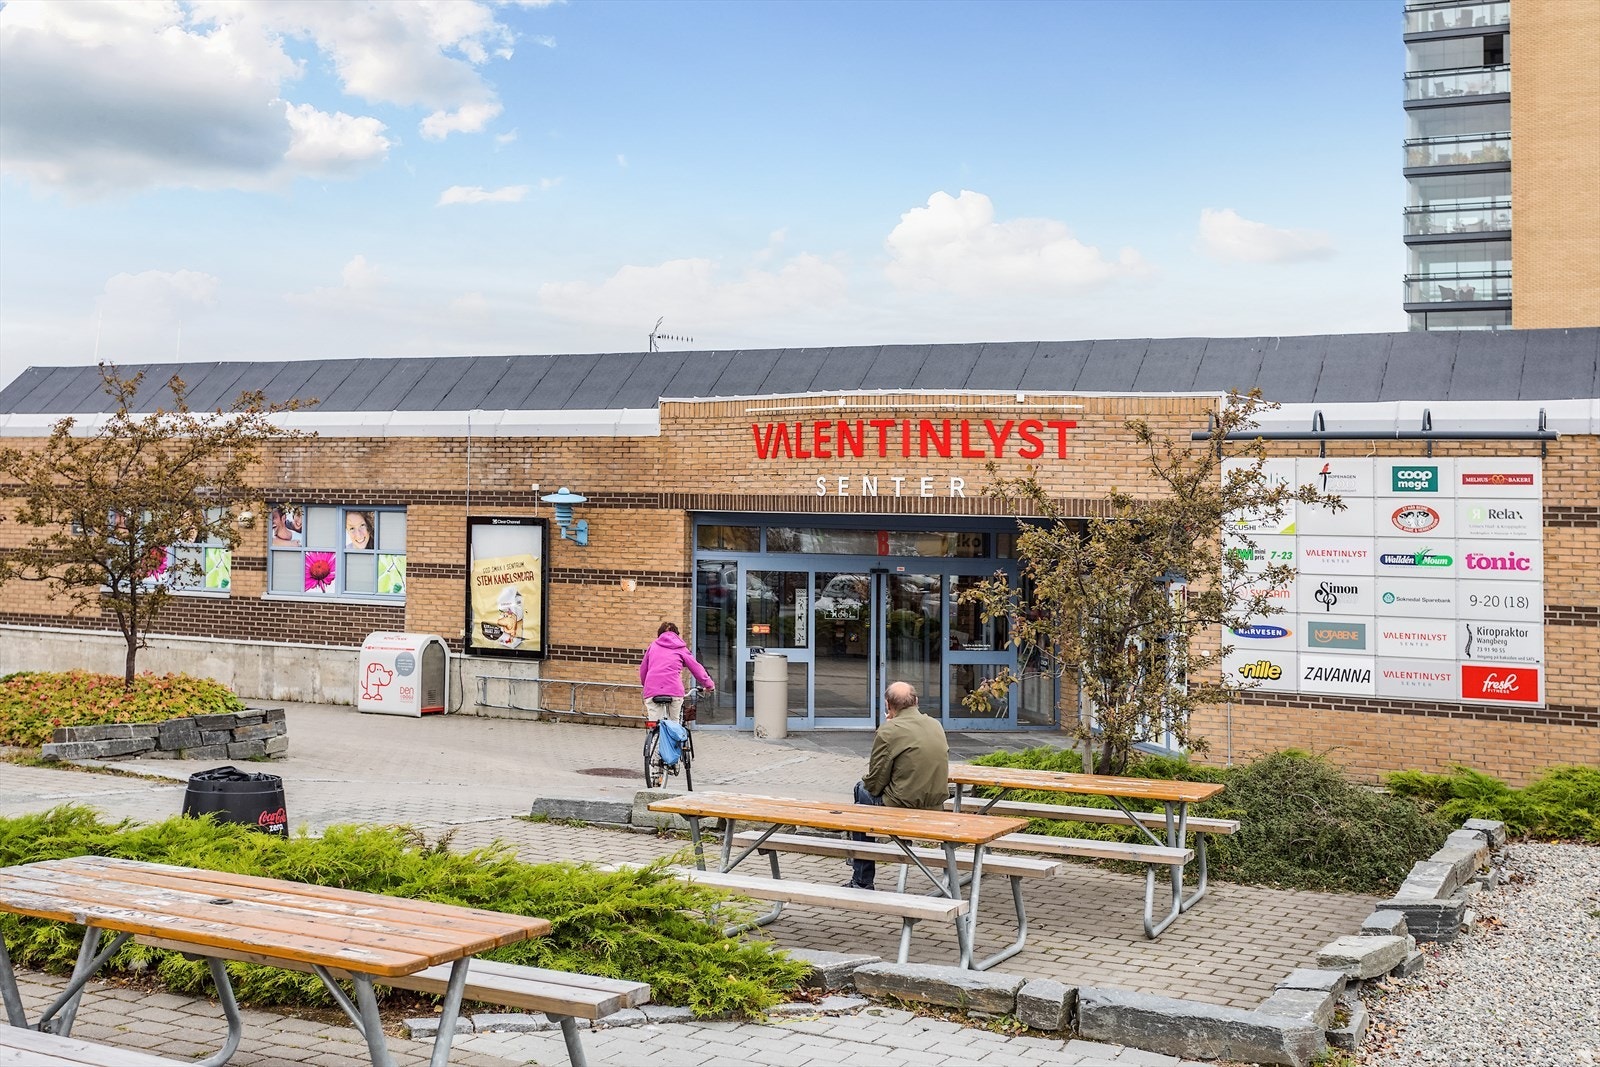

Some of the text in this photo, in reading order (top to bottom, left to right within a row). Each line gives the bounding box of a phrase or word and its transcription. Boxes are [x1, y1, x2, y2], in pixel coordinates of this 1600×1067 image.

[752, 419, 1077, 459] VALENTINLYST
[1397, 470, 1432, 480] coop
[816, 476, 966, 498] SENTER
[1397, 481, 1429, 490] mega
[1488, 508, 1523, 520] Relax
[1270, 551, 1293, 560] 7-23
[1306, 549, 1368, 557] VALENTINLYST
[1422, 557, 1448, 565] Moum
[1465, 551, 1530, 571] tonic
[476, 573, 493, 587] STEM
[1469, 594, 1529, 609] 9-20 (18)
[1238, 628, 1282, 636] NARVESEN
[1314, 629, 1358, 643] NOTABENE
[1383, 631, 1447, 641] VALENTINLYST
[1476, 626, 1528, 638] Kiropraktor
[1476, 637, 1508, 646] Wangberg
[1304, 667, 1371, 683] ZAVANNA
[1383, 671, 1452, 681] VALENTINLYST
[1482, 673, 1519, 693] fresh
[269, 824, 284, 832] zero
